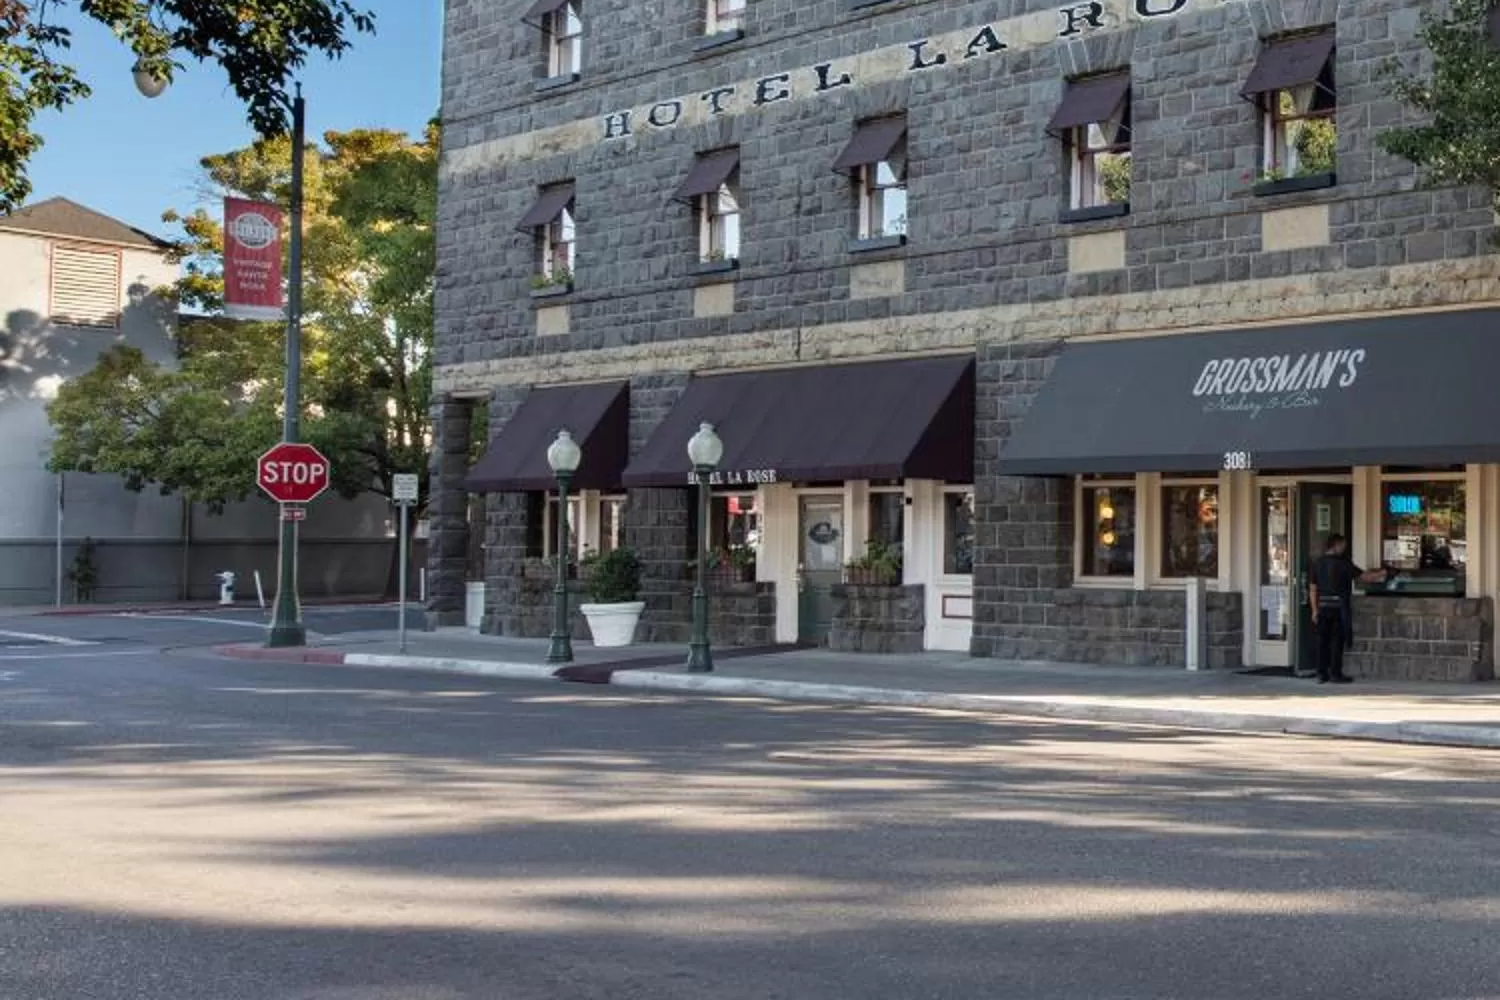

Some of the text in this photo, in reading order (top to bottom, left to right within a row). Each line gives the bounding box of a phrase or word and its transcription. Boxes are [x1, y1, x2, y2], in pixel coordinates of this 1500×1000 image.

[605, 63, 851, 138] HOTEL
[908, 25, 1008, 71] LA
[1192, 349, 1366, 396] GROSSMAN'S
[263, 461, 325, 485] STOP
[727, 470, 742, 484] LA
